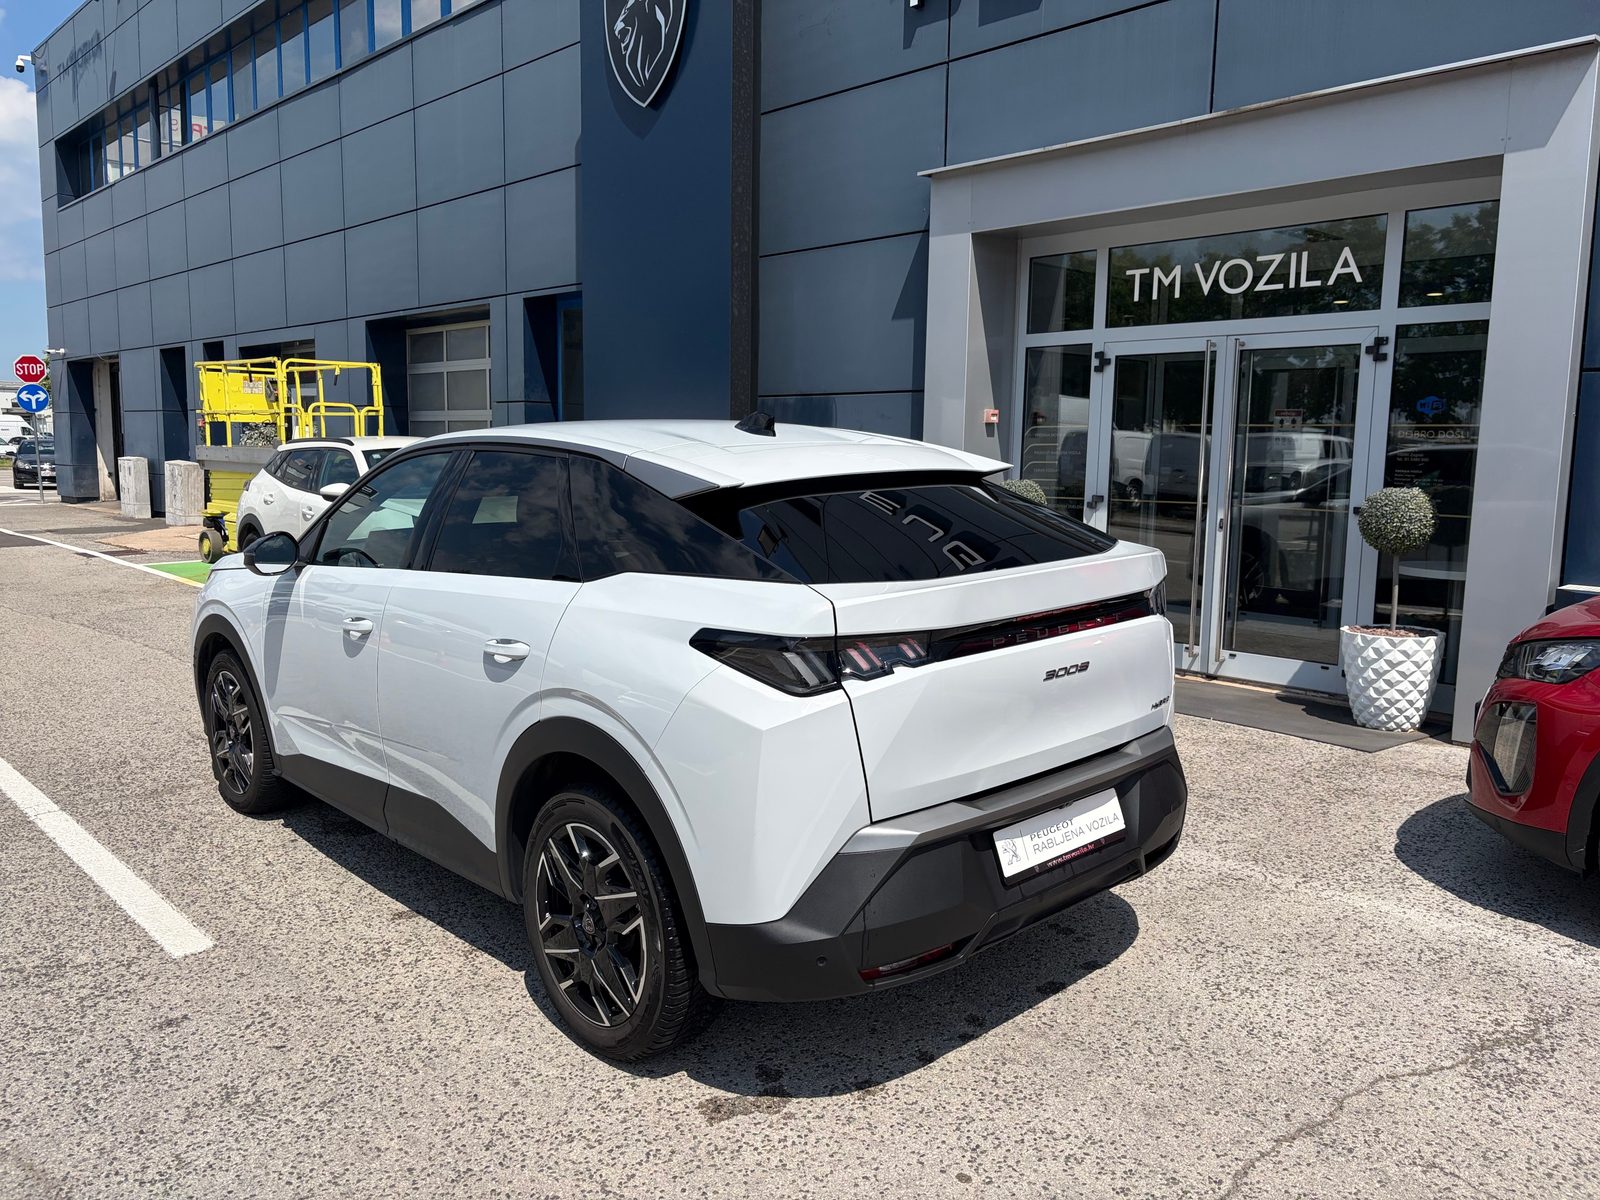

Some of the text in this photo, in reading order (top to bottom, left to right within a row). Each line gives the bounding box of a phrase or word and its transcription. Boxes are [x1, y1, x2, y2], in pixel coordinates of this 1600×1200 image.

[1126, 246, 1363, 302] TM VOZILA
[16, 363, 44, 375] STOP
[1397, 430, 1435, 440] DOBRO
[992, 613, 1120, 647] PEUGEOT
[1043, 661, 1090, 682] 3008
[1030, 819, 1074, 841] PEUGEOT
[1033, 813, 1120, 854] RABLJENA VOZILA
